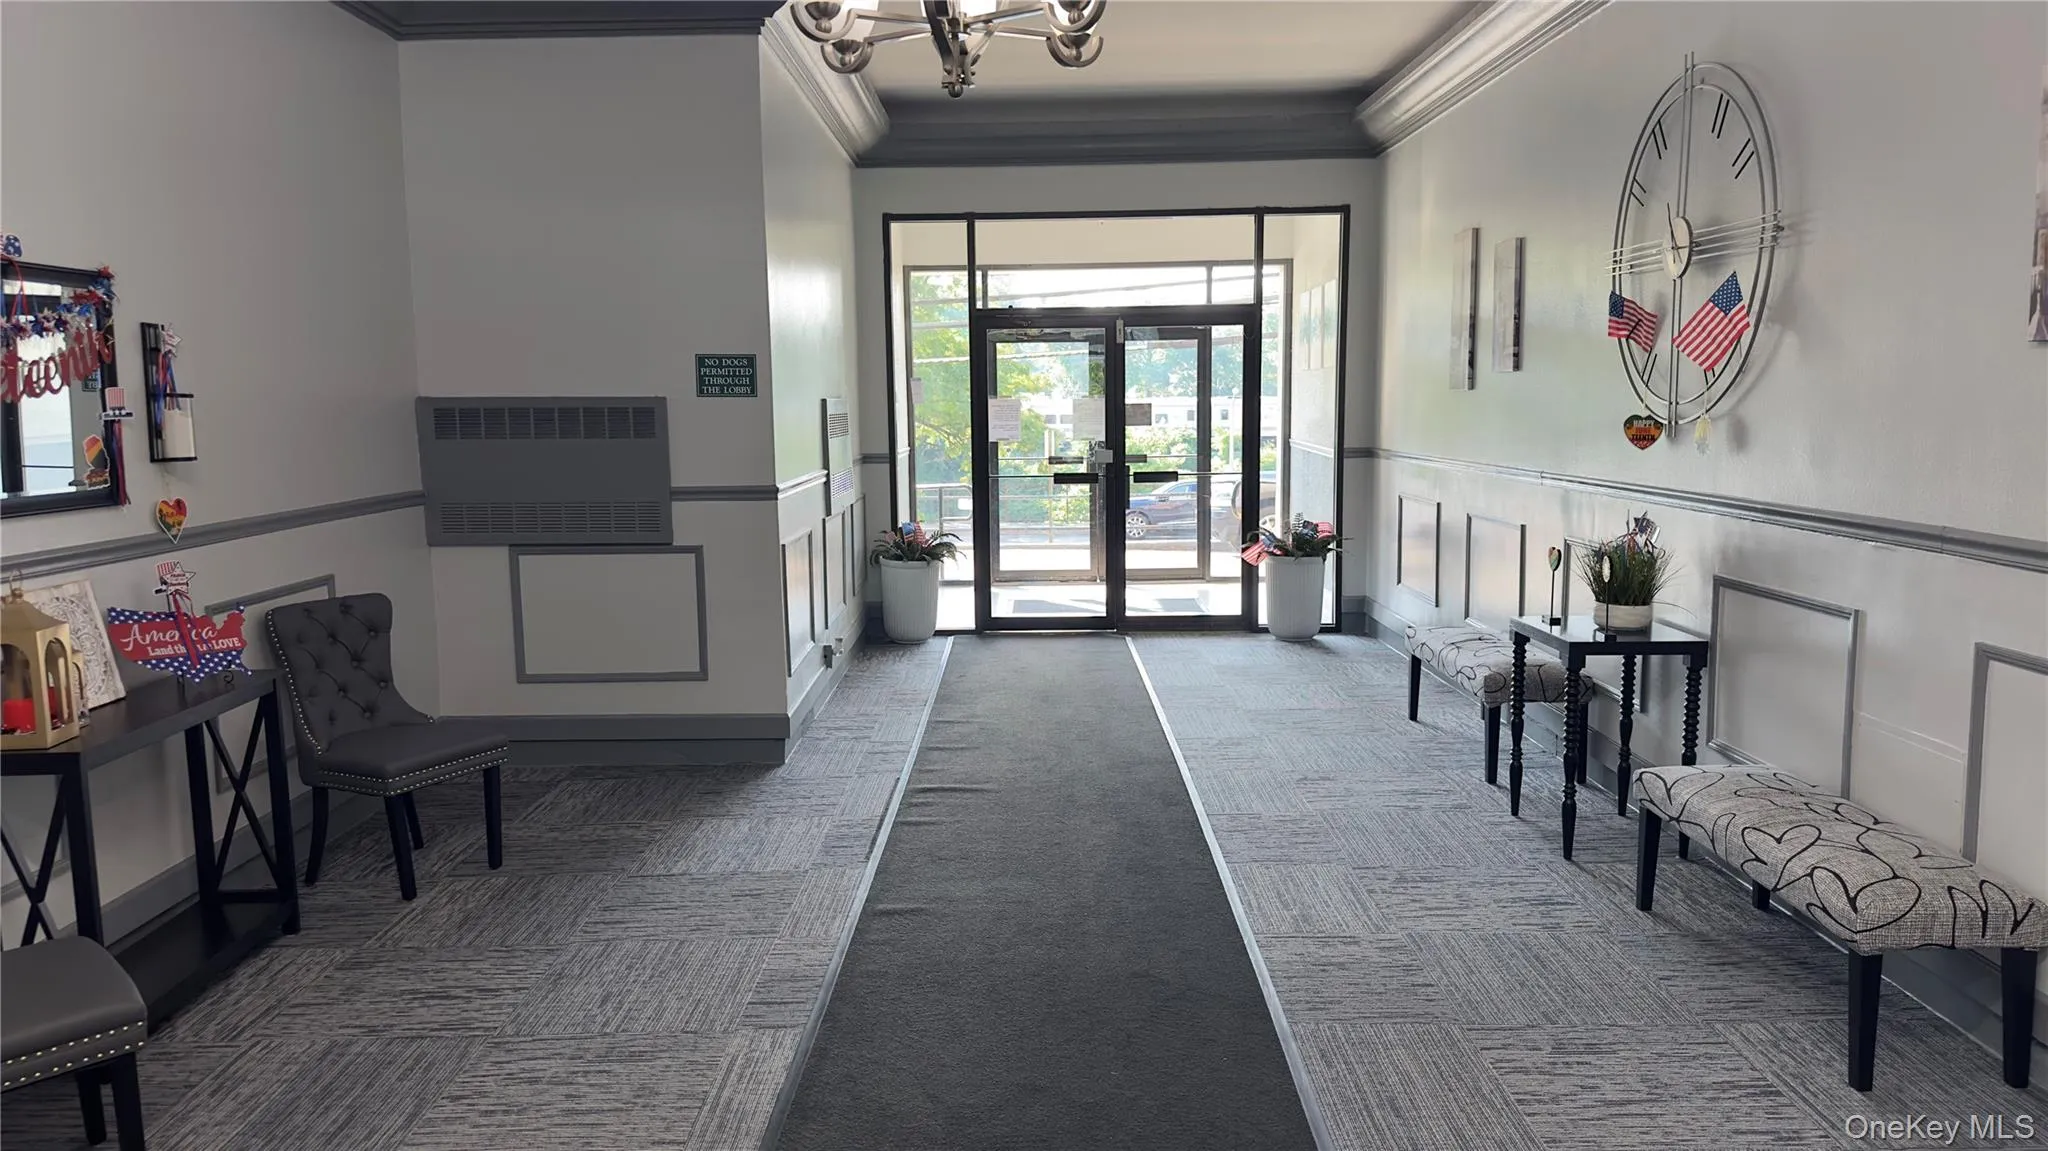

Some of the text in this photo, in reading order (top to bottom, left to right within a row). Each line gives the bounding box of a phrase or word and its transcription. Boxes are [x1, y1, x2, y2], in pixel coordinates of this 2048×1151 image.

[704, 358, 748, 366] NO DOGS
[700, 367, 753, 376] PERMITTED
[703, 377, 750, 385] THROUGH
[702, 386, 752, 394] THE LOBBY
[1633, 419, 1656, 427] HAPPY
[148, 642, 174, 656] Land
[211, 637, 241, 650] LOVE
